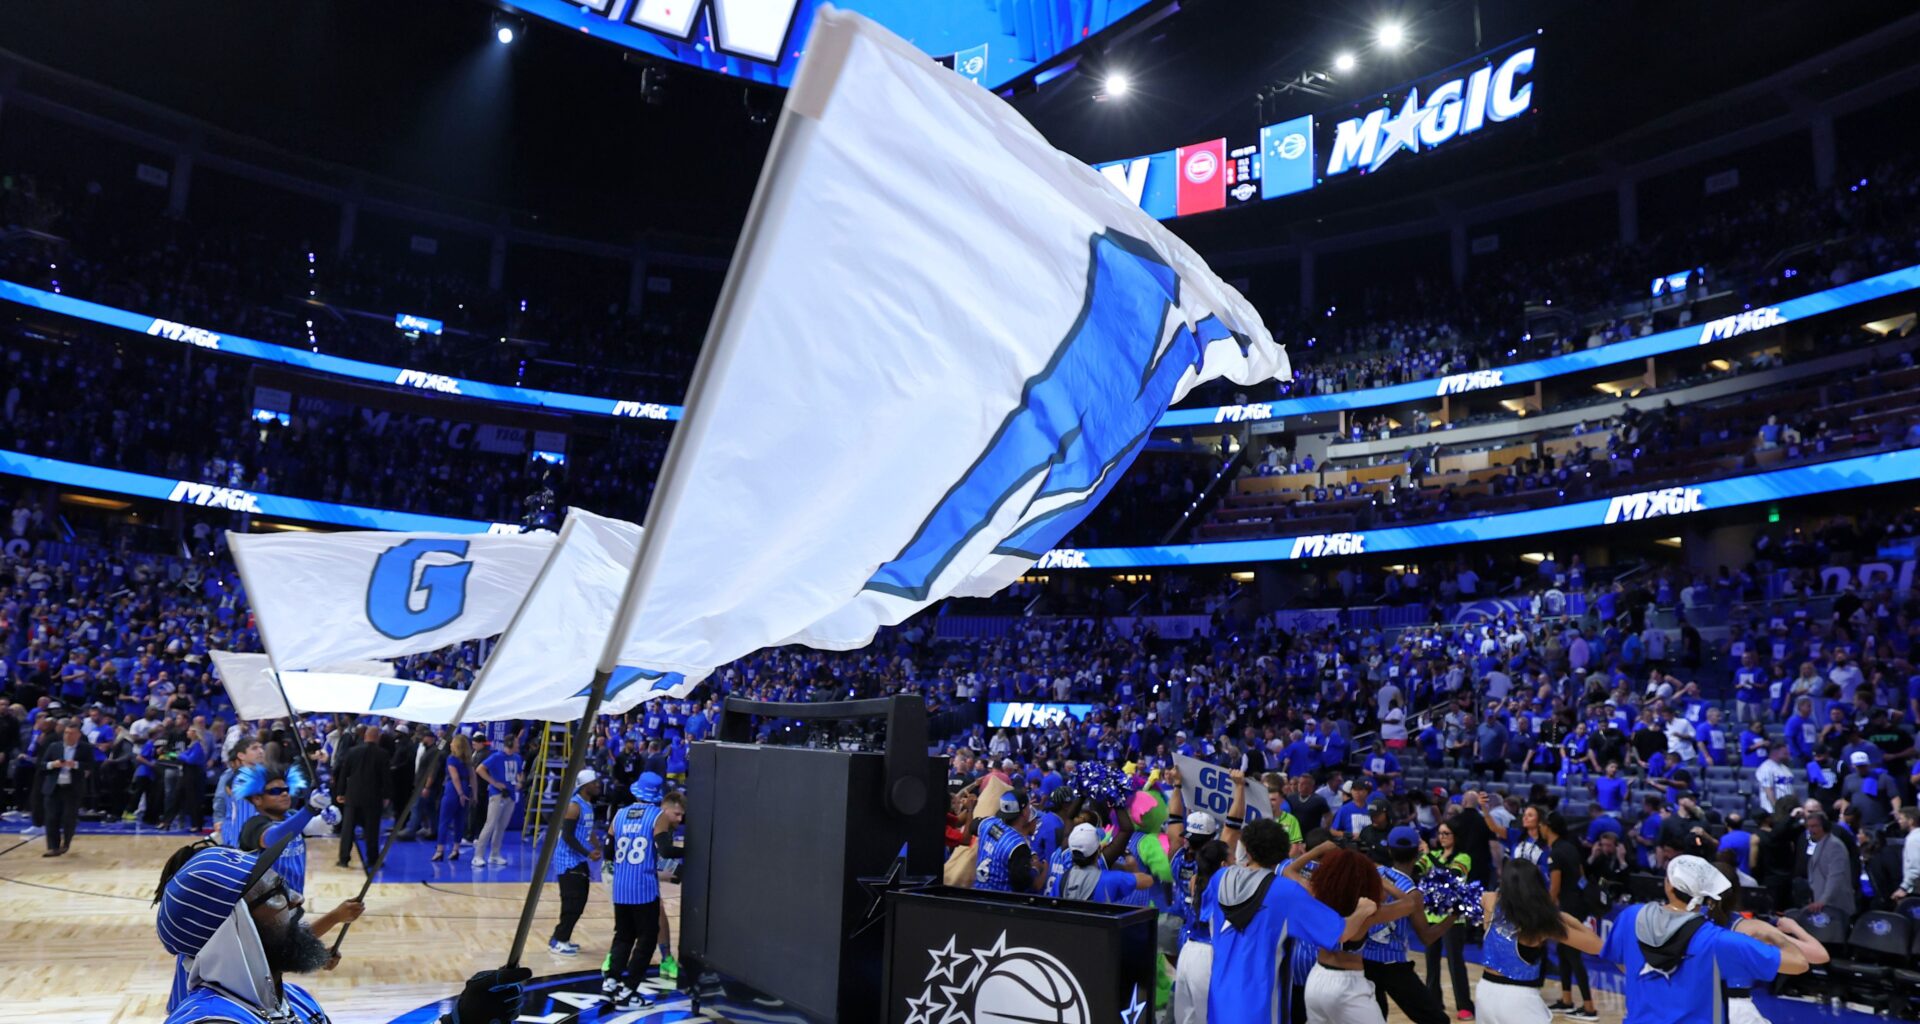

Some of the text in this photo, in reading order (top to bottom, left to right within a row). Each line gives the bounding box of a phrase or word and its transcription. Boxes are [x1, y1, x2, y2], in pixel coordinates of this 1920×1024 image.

[1326, 48, 1536, 176] MAGIC
[366, 539, 473, 640] G
[1194, 787, 1262, 826] LOD
[616, 836, 648, 864] 88
